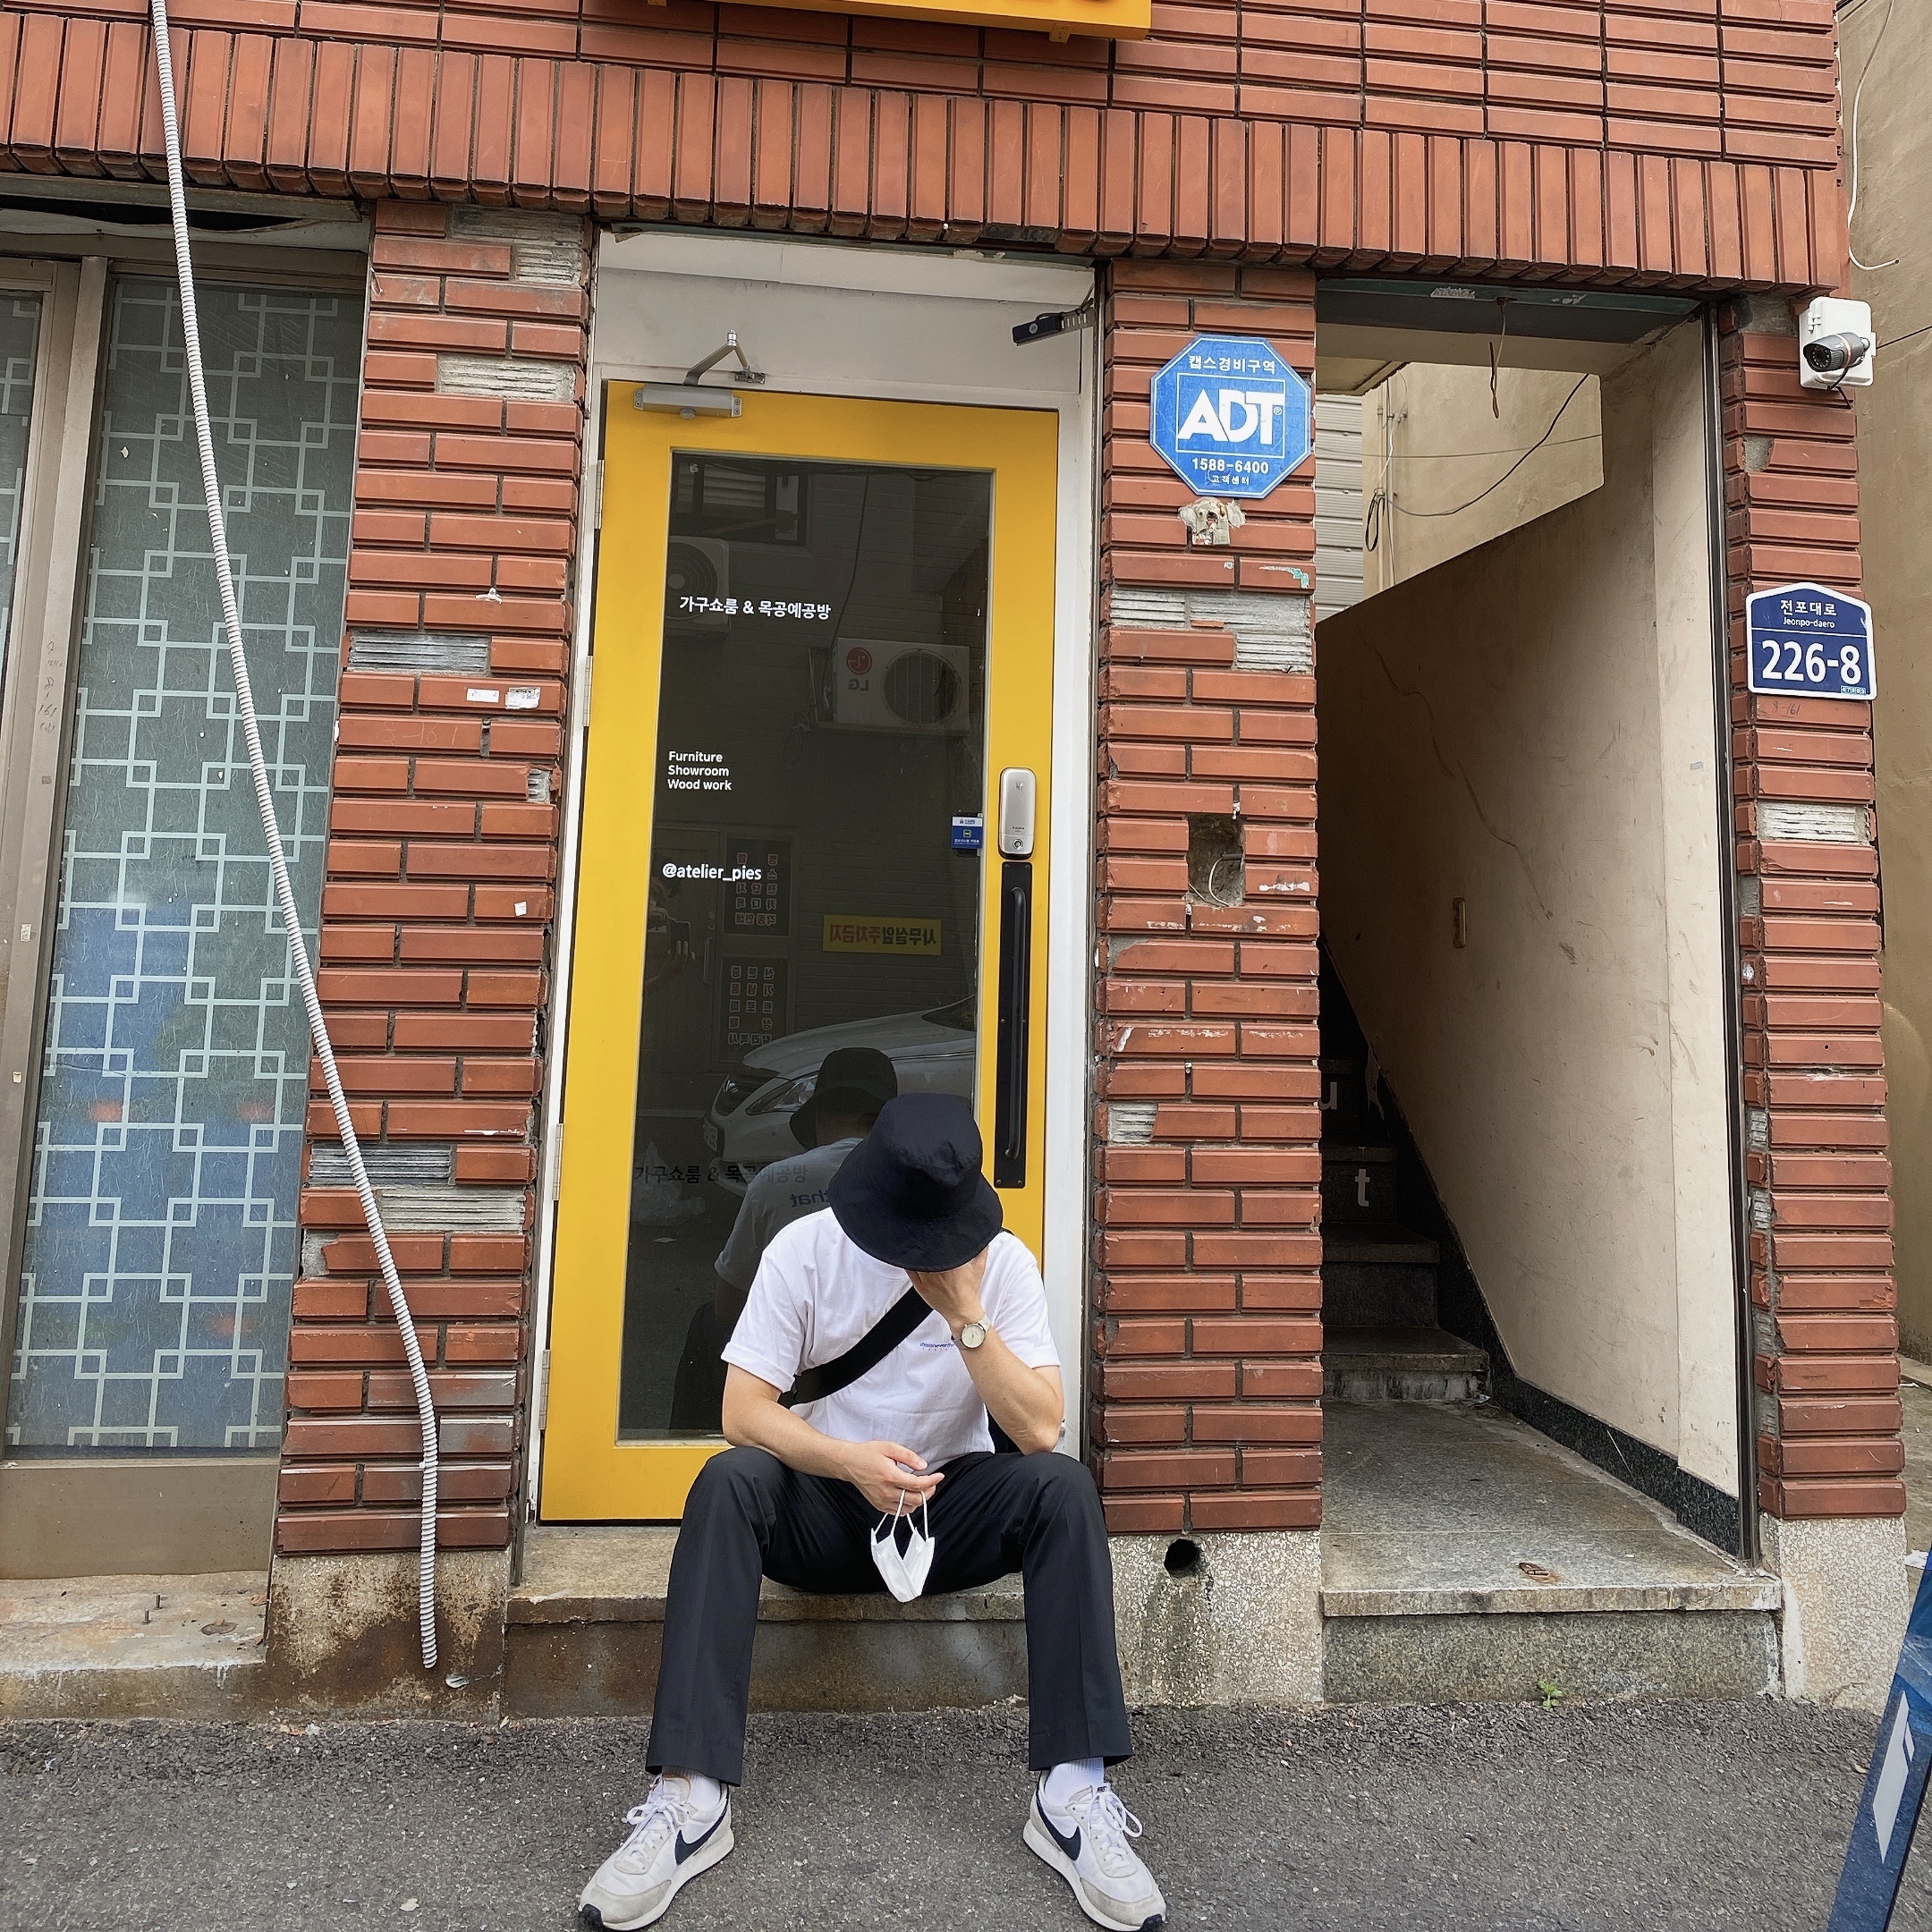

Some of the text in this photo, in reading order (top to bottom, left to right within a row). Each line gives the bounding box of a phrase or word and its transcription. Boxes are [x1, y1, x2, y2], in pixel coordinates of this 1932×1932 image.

[1188, 355, 1276, 374] 캡스경비구역
[1177, 388, 1284, 445] ADT
[1191, 457, 1269, 474] 1588-6400
[1211, 475, 1250, 486] 고객센터
[679, 596, 832, 620] 가구쇼룸 & 목공예공방
[1780, 599, 1837, 616] 전포대로
[1783, 617, 1835, 628] Jeonpo-daero
[1761, 640, 1861, 685] 226-8
[668, 750, 724, 763] Furniture
[667, 765, 730, 776] Showroom
[667, 778, 733, 791] Wood work
[662, 862, 762, 881] @atelier_pies
